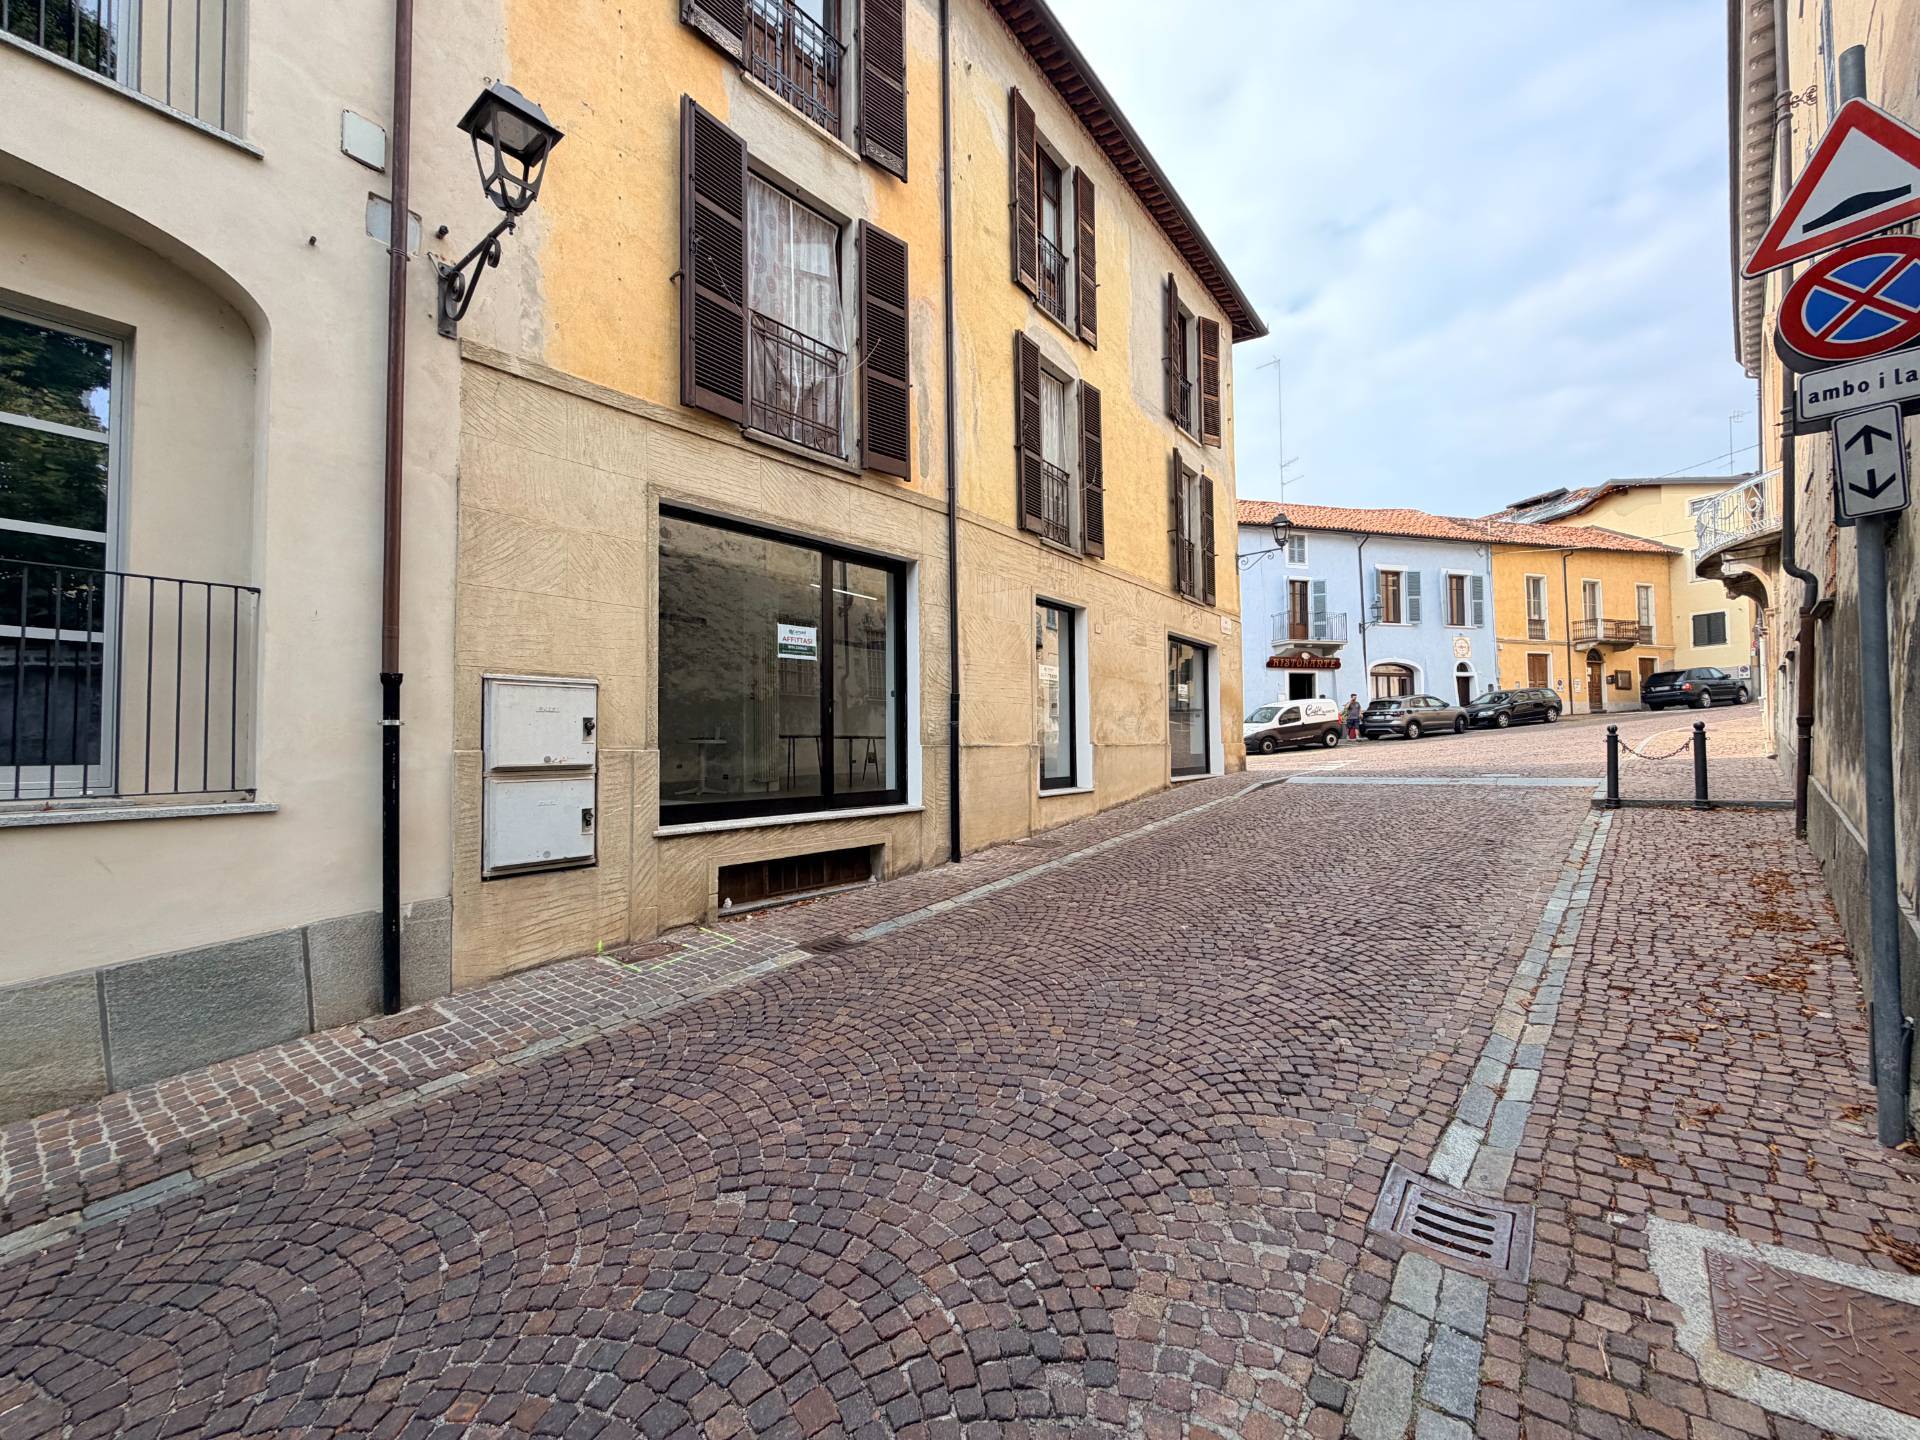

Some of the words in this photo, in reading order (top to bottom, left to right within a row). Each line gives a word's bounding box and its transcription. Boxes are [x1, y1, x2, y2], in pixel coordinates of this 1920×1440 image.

[1808, 380, 1869, 403] ambo
[1879, 372, 1884, 389] i
[783, 636, 812, 645] AFFITTASI
